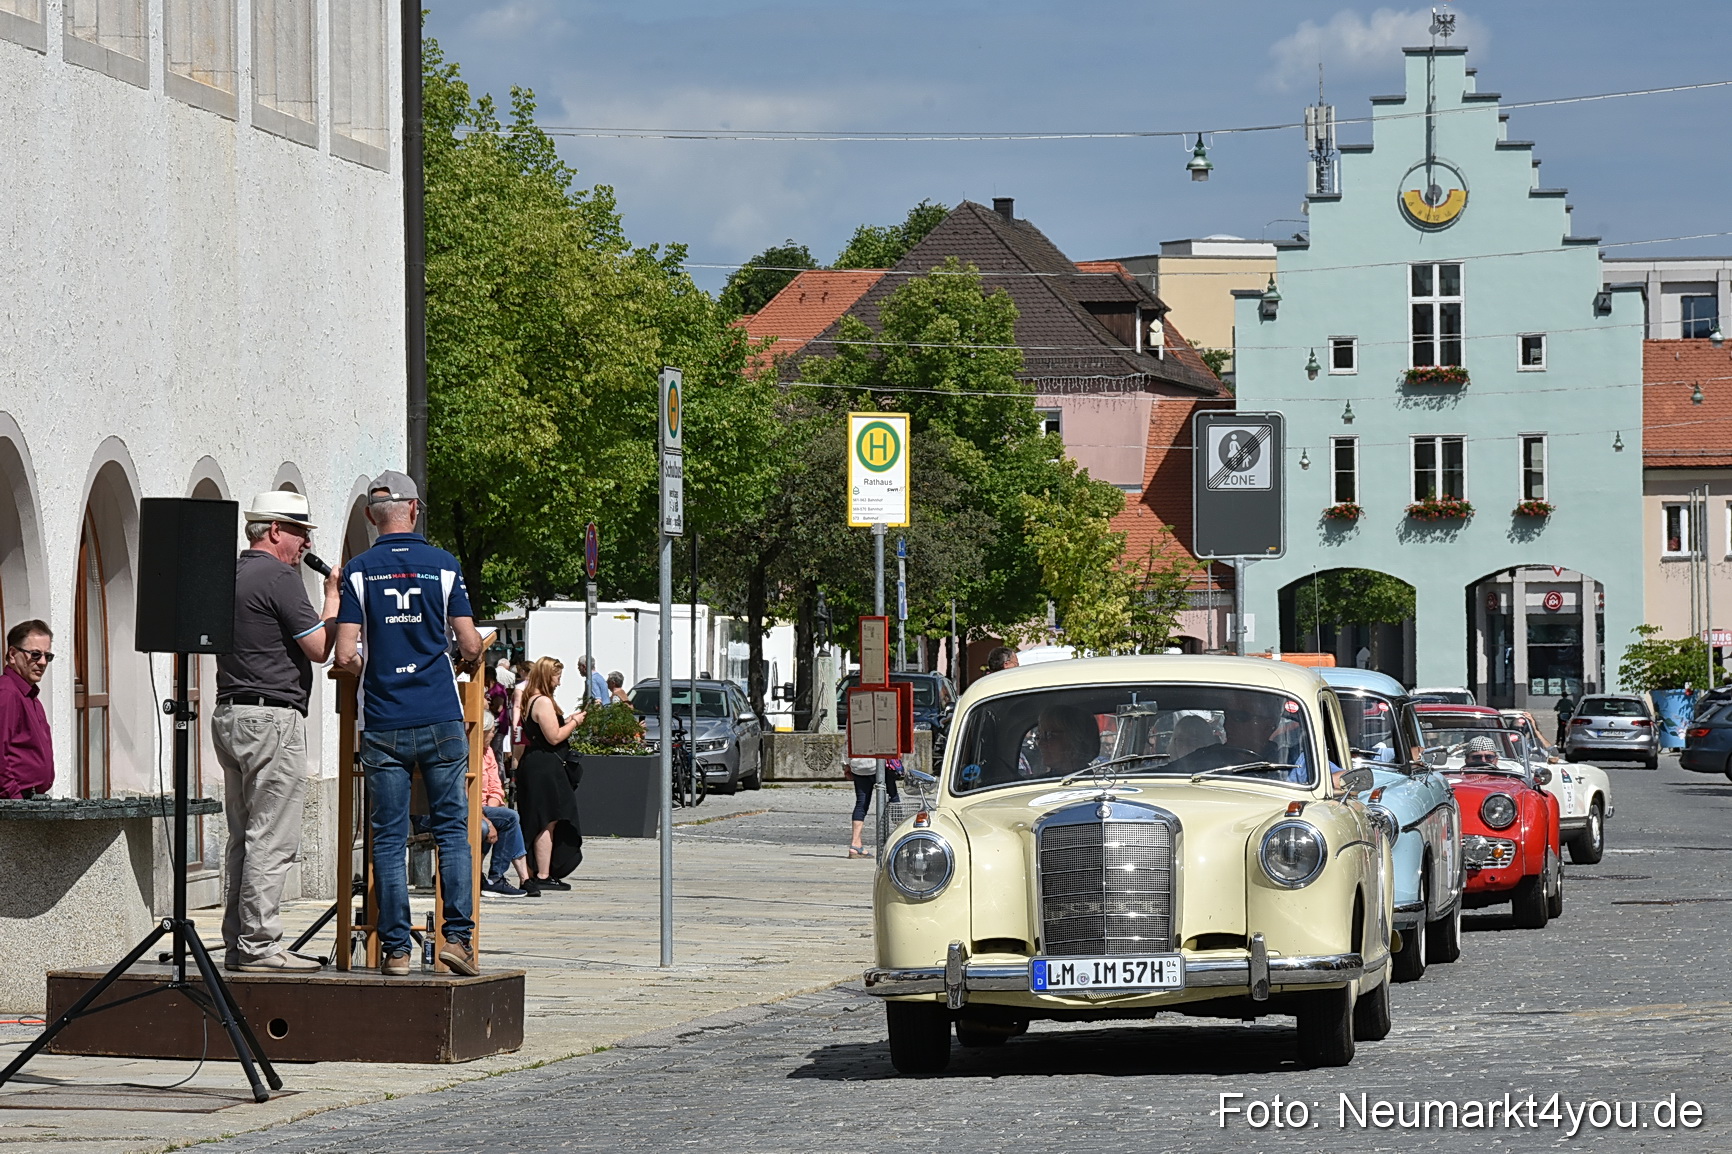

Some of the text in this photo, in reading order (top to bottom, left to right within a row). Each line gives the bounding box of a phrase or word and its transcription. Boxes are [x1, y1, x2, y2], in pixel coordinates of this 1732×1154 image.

[869, 432, 887, 461] H
[863, 478, 893, 486] Rathaus
[1223, 475, 1256, 486] ZONE
[385, 613, 422, 623] randstad
[1166, 960, 1177, 968] 04
[1047, 960, 1164, 986] LM IM 57H
[1037, 978, 1044, 986] D
[1166, 975, 1178, 984] 10
